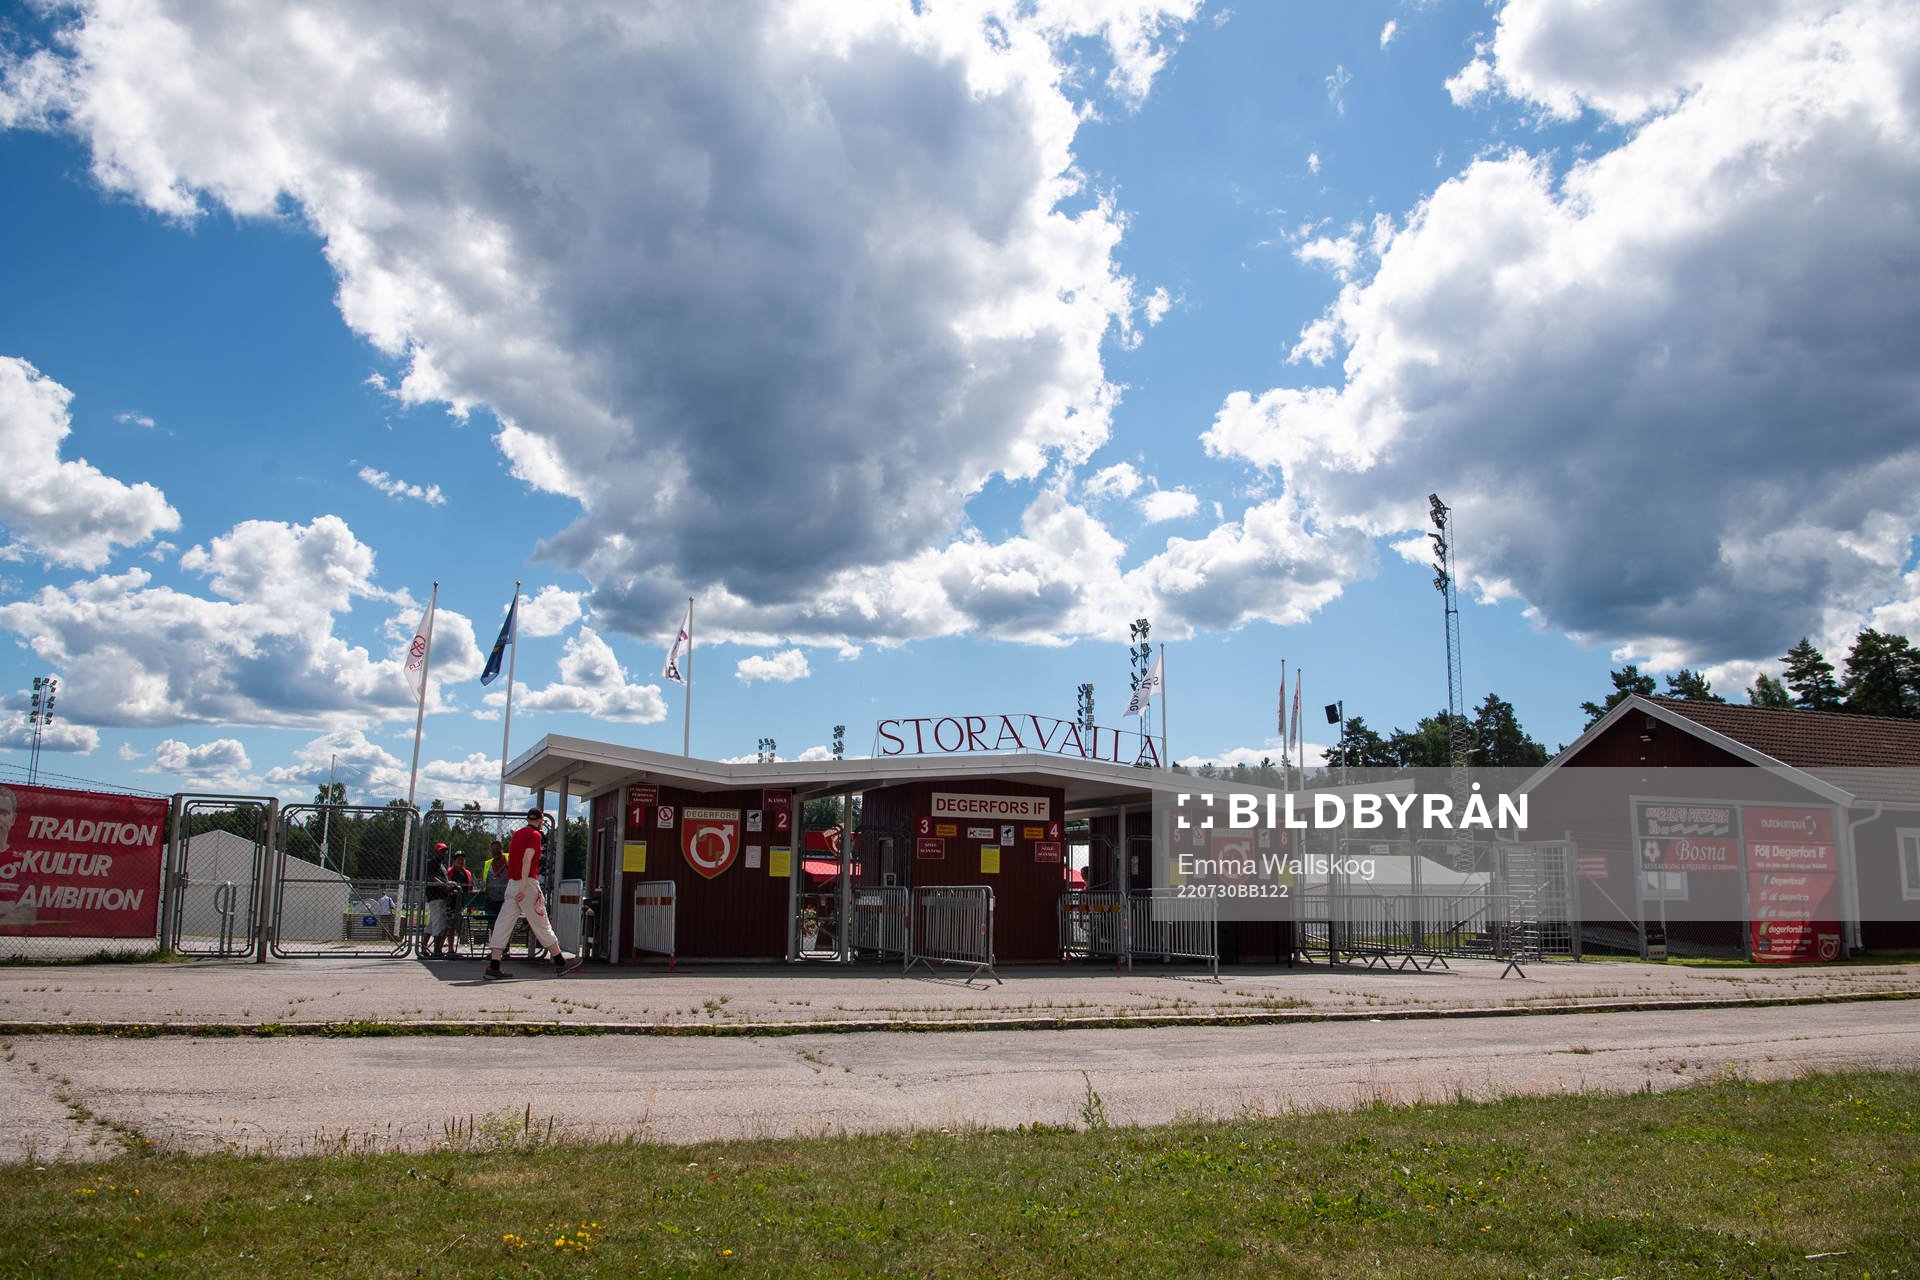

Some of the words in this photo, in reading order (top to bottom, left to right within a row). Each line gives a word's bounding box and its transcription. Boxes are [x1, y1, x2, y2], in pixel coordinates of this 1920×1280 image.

[936, 798, 1029, 815] DEGERFORS
[1033, 802, 1046, 815] IF
[632, 807, 640, 824] 1
[685, 810, 737, 820] DEGERFORS
[777, 813, 788, 828] 2
[1688, 808, 1730, 824] PIZZERIA
[27, 816, 158, 846] TRADITION
[920, 819, 929, 834] 3
[1050, 823, 1059, 838] 4
[1760, 818, 1802, 830] outokumpu
[1173, 828, 1181, 842] 5
[1281, 831, 1288, 845] 6
[1675, 840, 1727, 861] Bosna
[1754, 845, 1771, 859] Följ
[1772, 846, 1817, 860] Degerfors
[1818, 847, 1827, 858] IF
[20, 850, 113, 877] KULTUR
[16, 884, 144, 911] AMBITION
